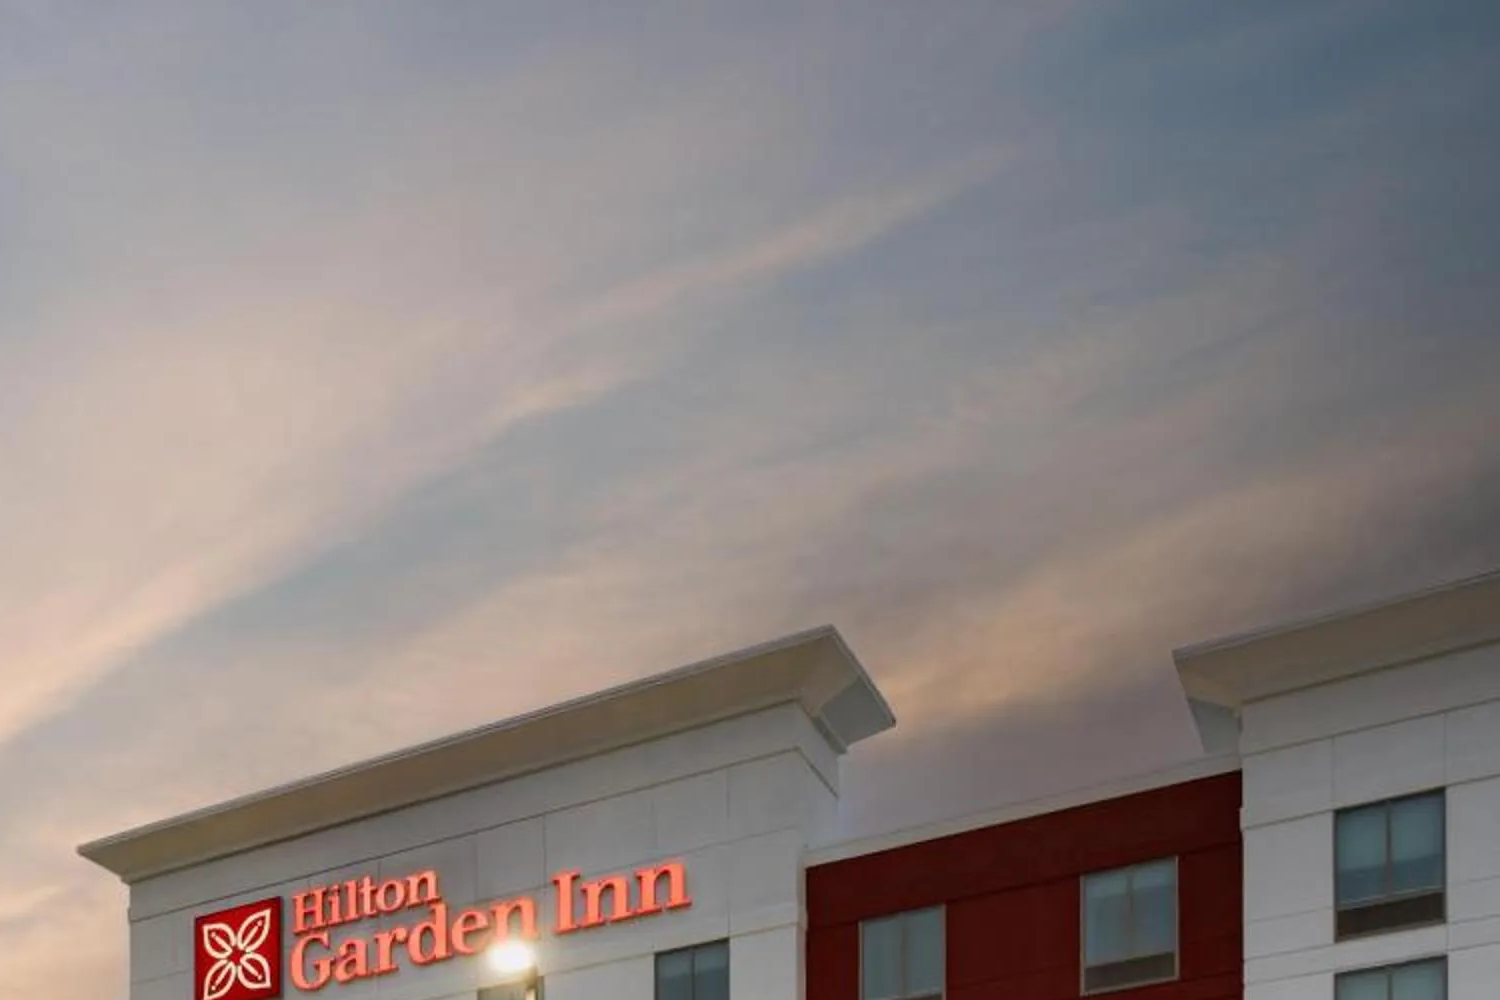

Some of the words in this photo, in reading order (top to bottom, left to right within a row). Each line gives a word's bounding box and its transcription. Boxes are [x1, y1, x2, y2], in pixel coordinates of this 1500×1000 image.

[290, 896, 537, 991] Garden
[552, 858, 691, 935] Inn
[292, 869, 440, 933] Hilton
